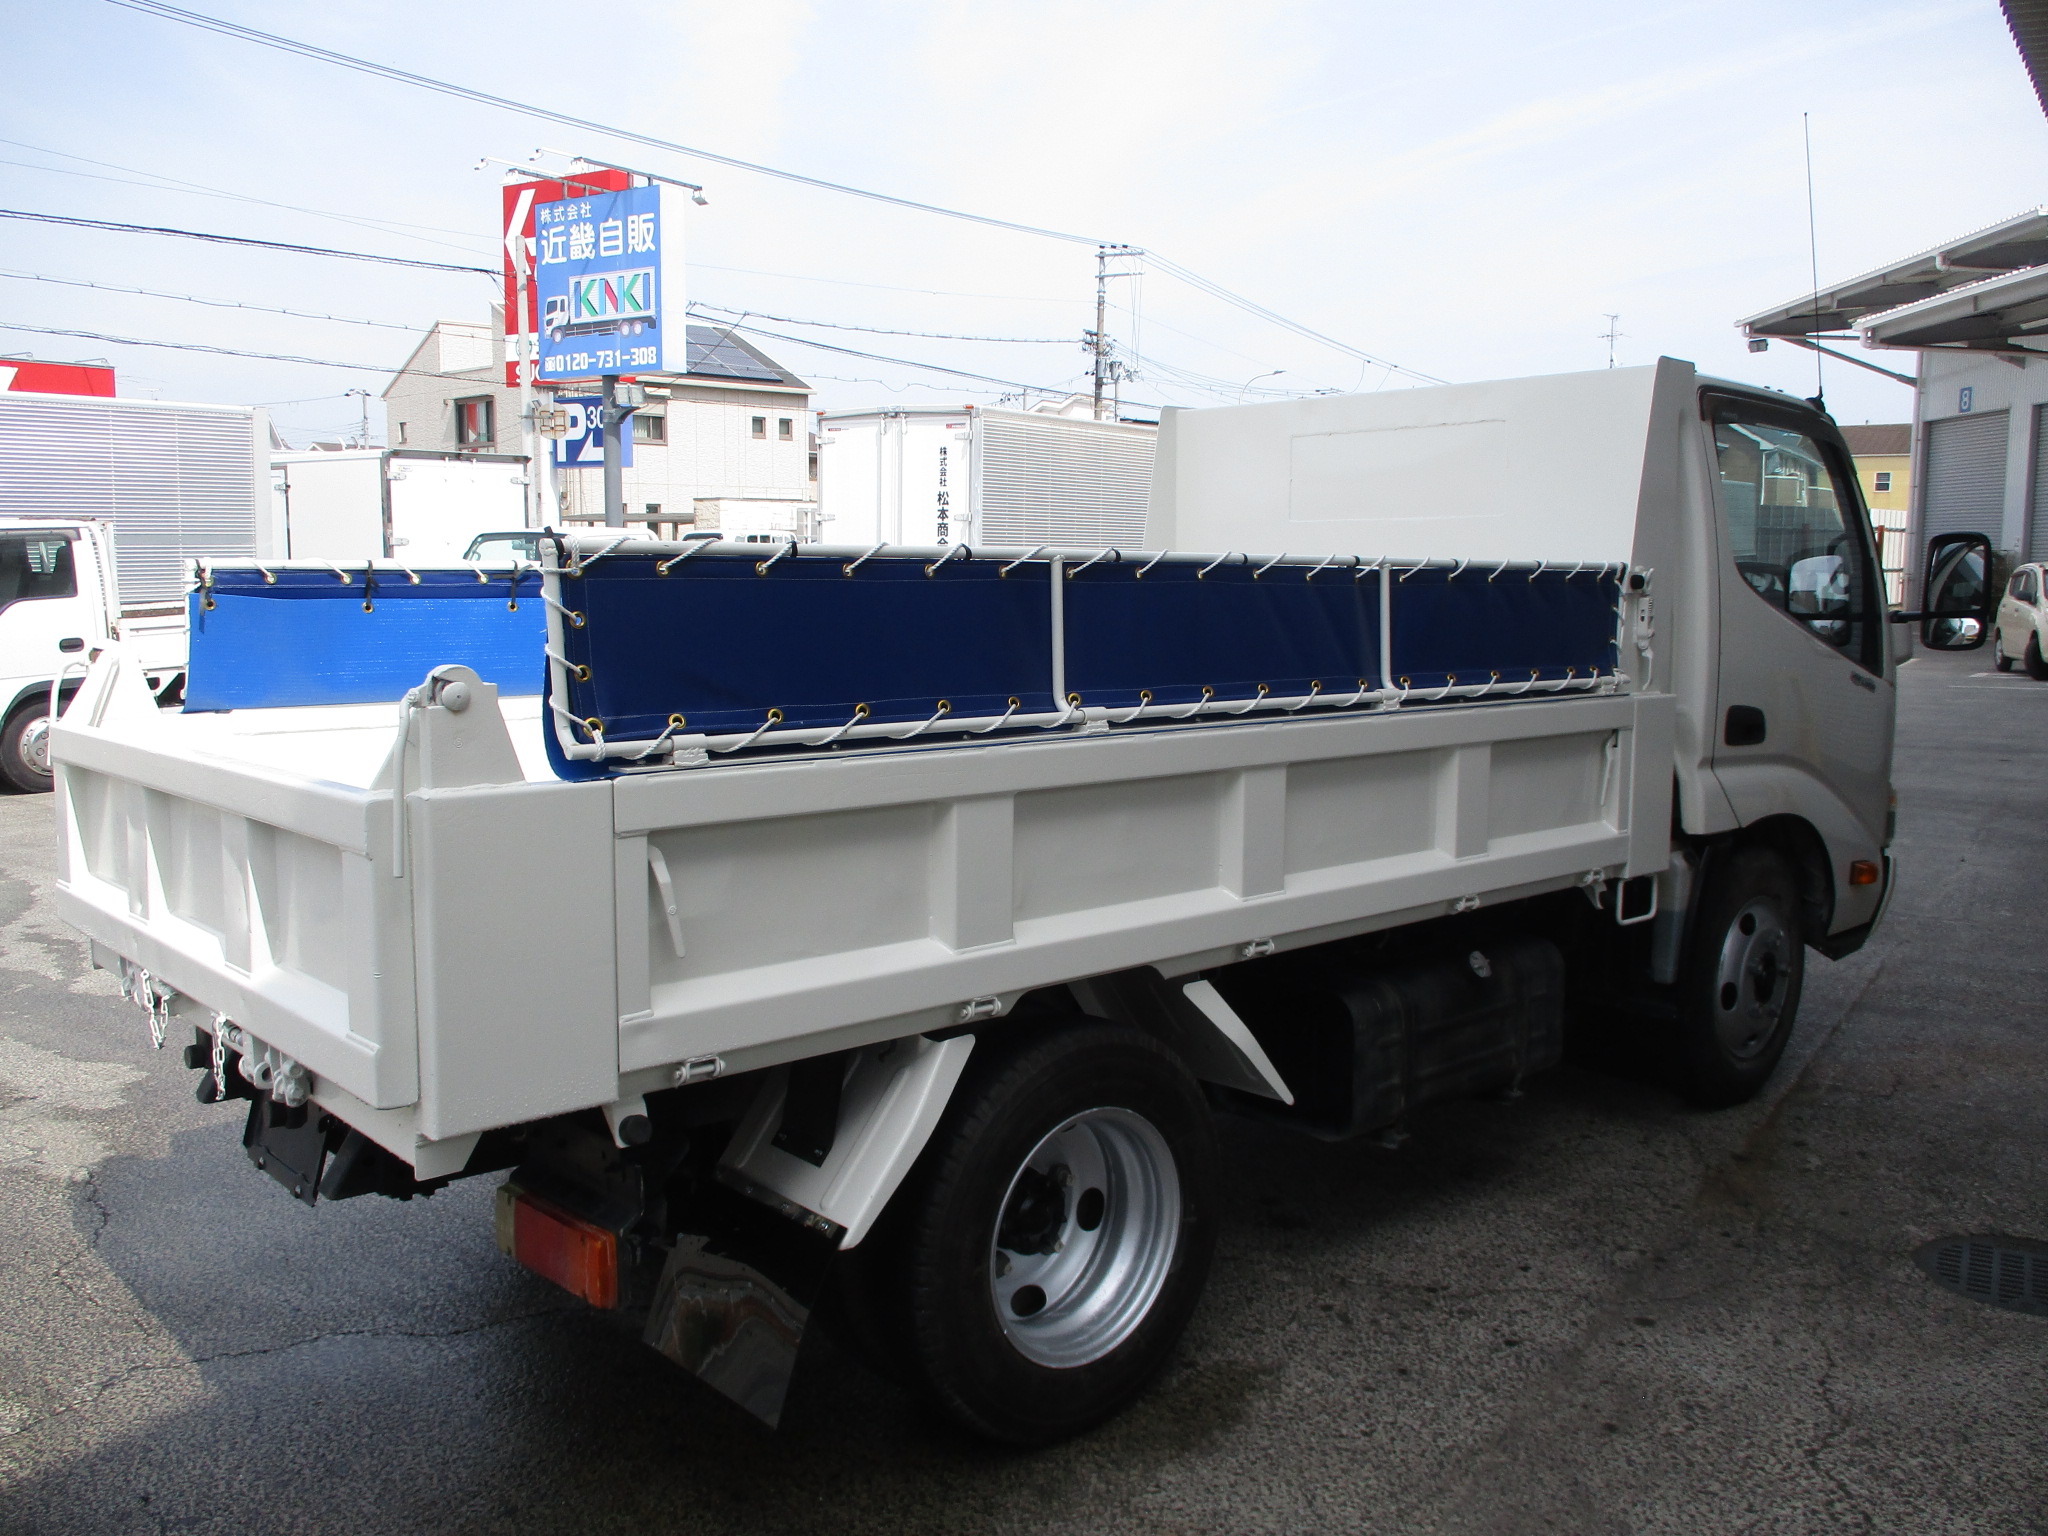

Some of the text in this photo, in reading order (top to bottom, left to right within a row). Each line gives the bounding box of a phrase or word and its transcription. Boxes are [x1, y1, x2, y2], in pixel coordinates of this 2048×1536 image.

[541, 201, 592, 224] 株式会社
[541, 213, 655, 265] 近畿自販
[556, 346, 657, 372] 0120-731-308
[1961, 390, 1970, 410] 8
[939, 446, 948, 487] 株式会社
